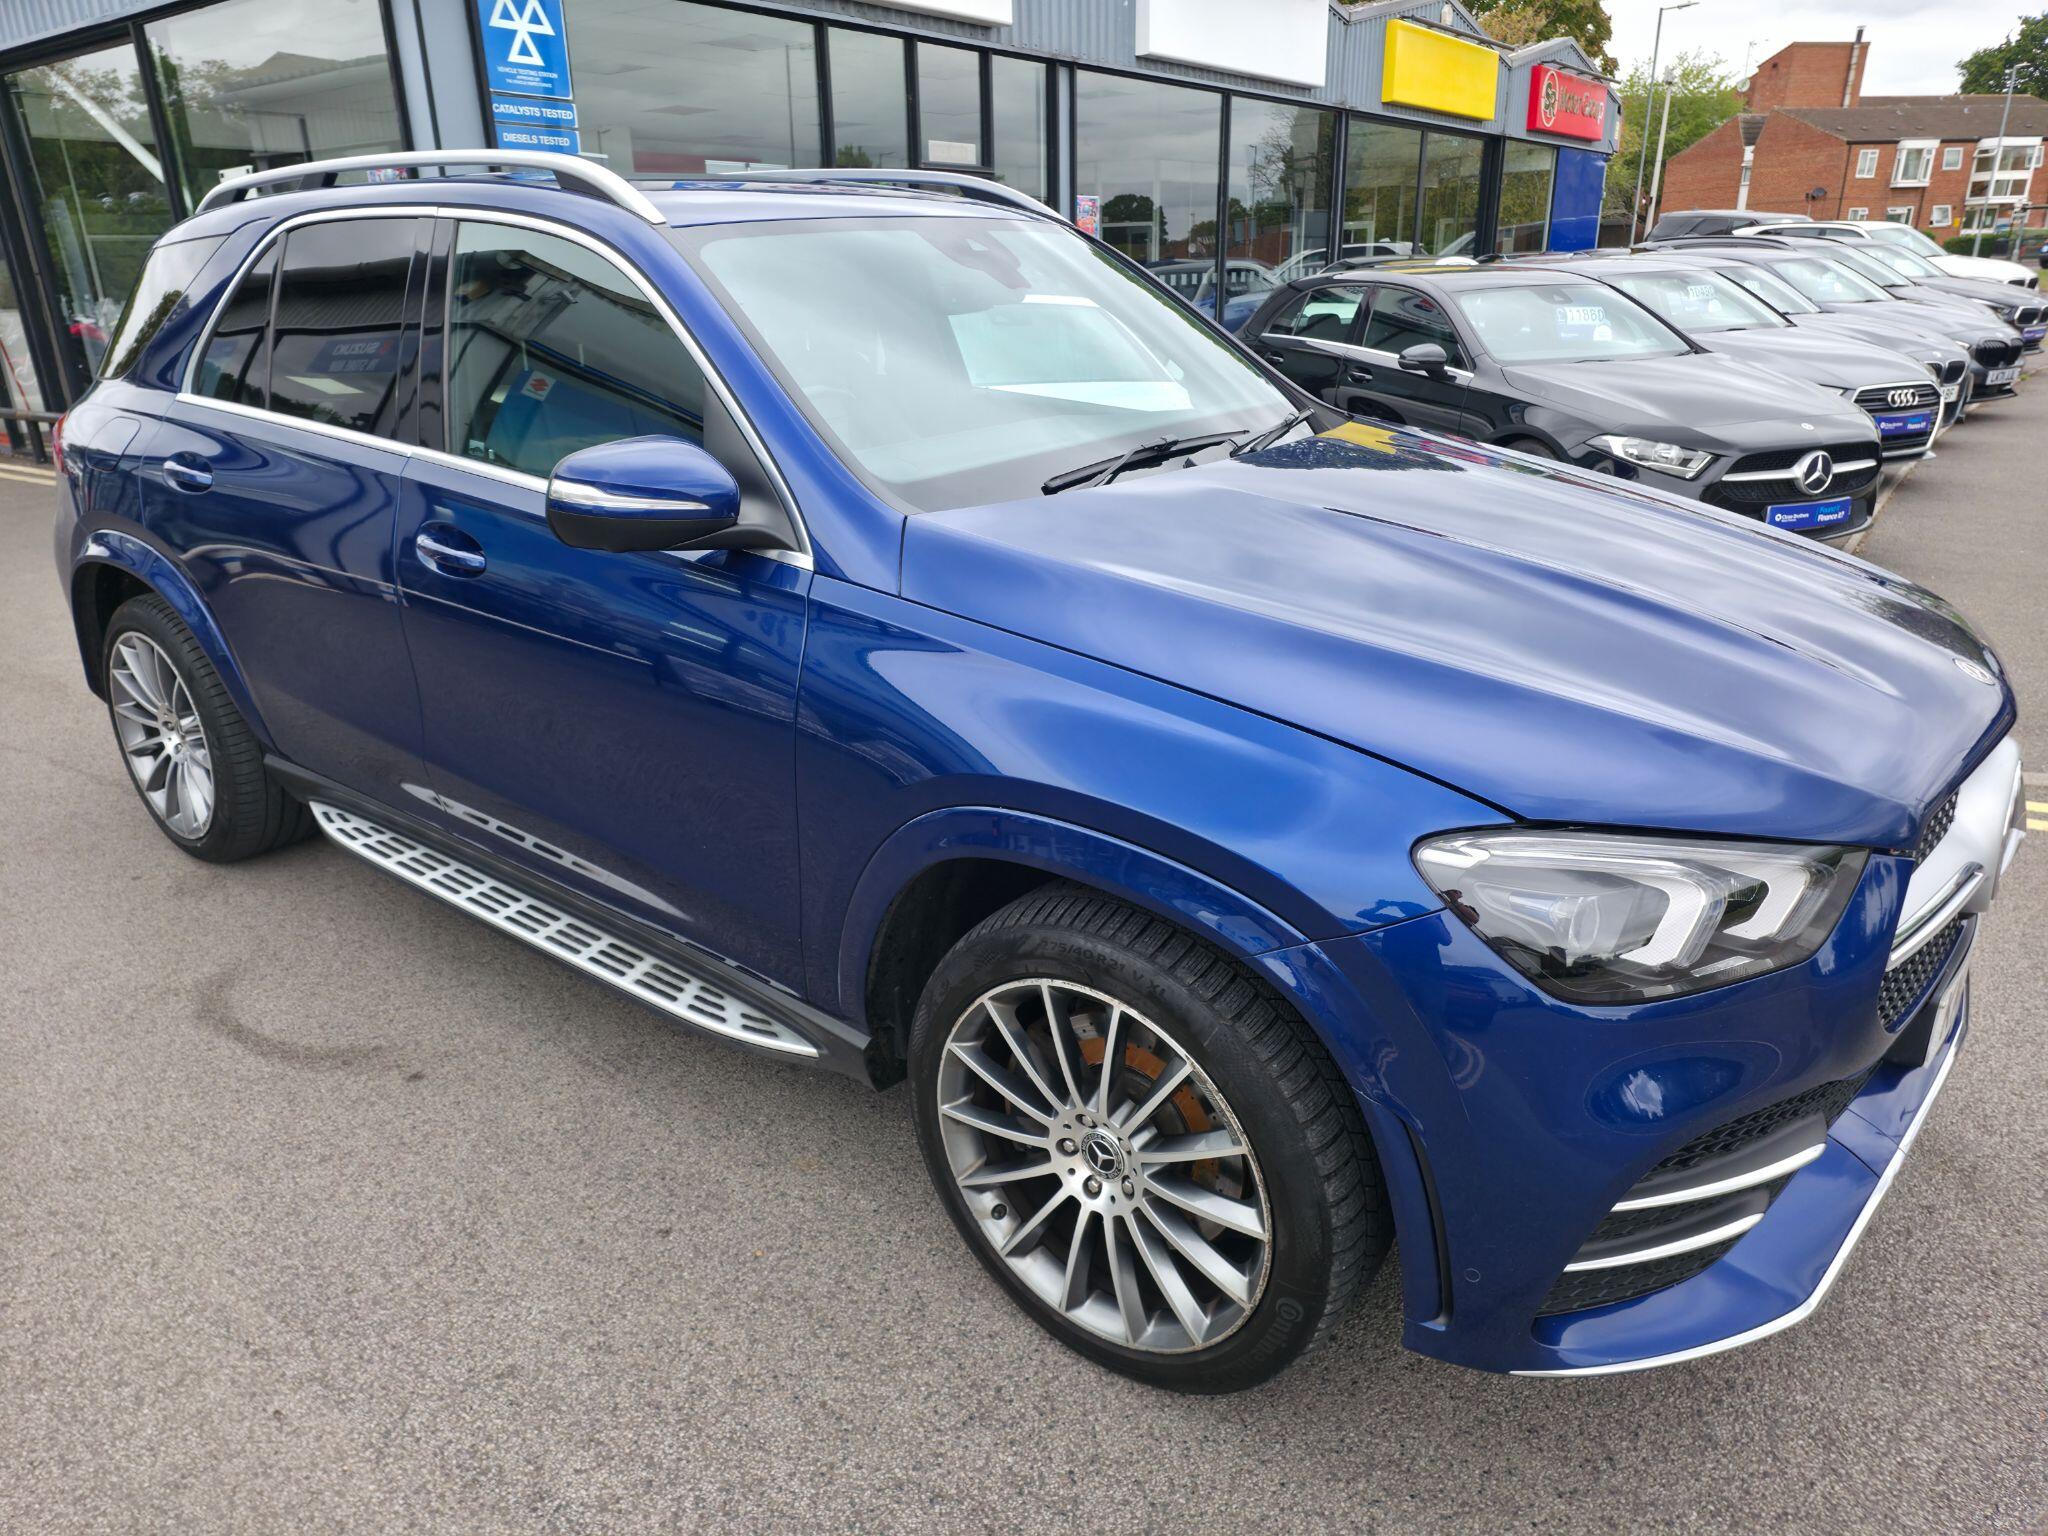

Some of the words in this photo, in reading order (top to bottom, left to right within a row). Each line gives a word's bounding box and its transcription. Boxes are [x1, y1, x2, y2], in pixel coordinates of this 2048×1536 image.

[492, 103, 540, 117] CATALYSTS
[542, 108, 574, 120] TESTED
[502, 132, 537, 144] DIESELS
[538, 135, 570, 146] TESTED
